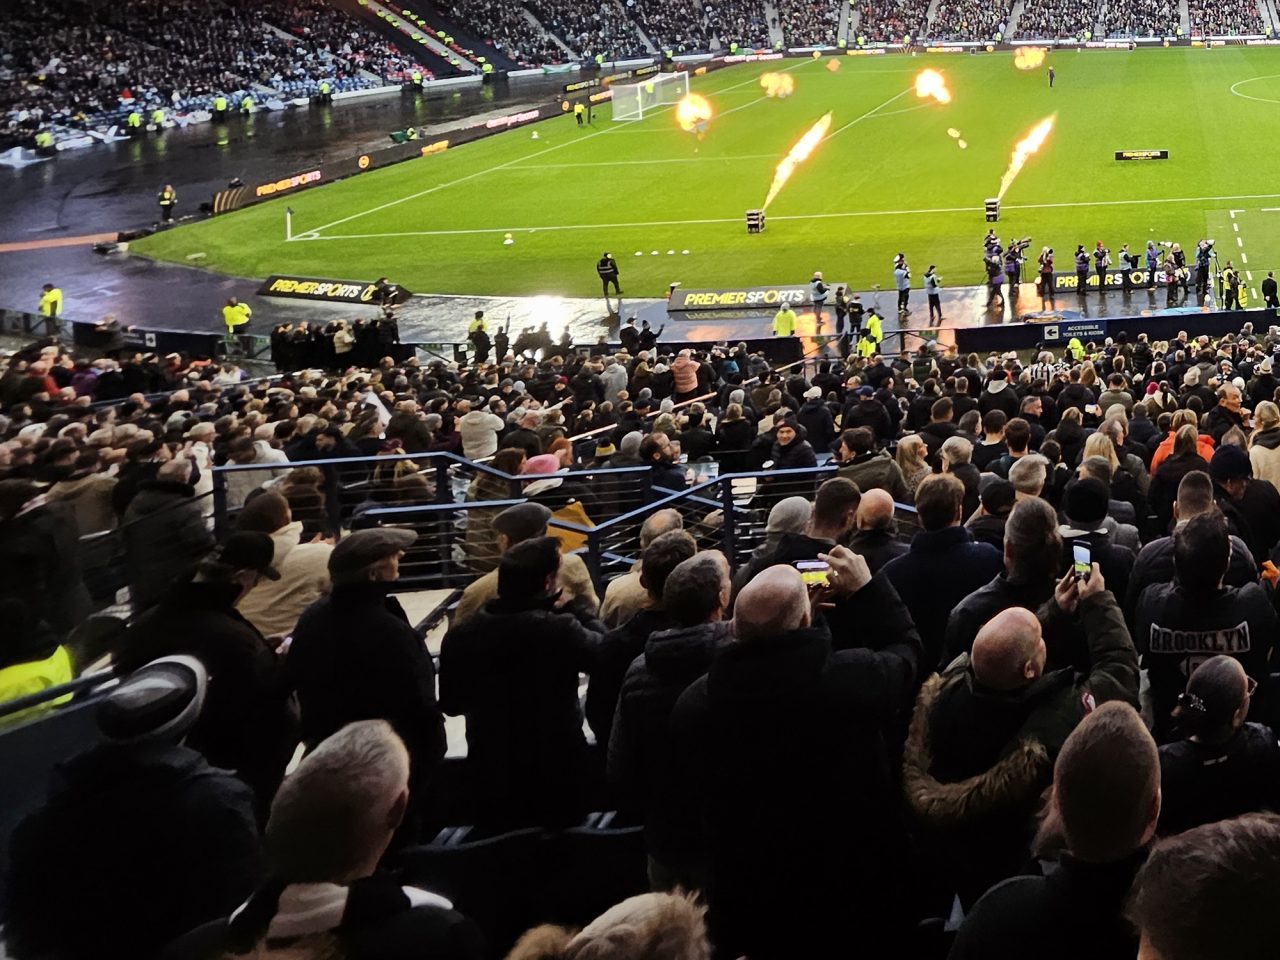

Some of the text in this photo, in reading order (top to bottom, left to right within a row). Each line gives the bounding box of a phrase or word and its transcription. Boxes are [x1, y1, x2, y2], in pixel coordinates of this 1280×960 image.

[270, 279, 361, 298] PREMIERSPORTS
[684, 289, 805, 305] PREMIERSPORTS
[1150, 622, 1251, 653] BROOKLYN
